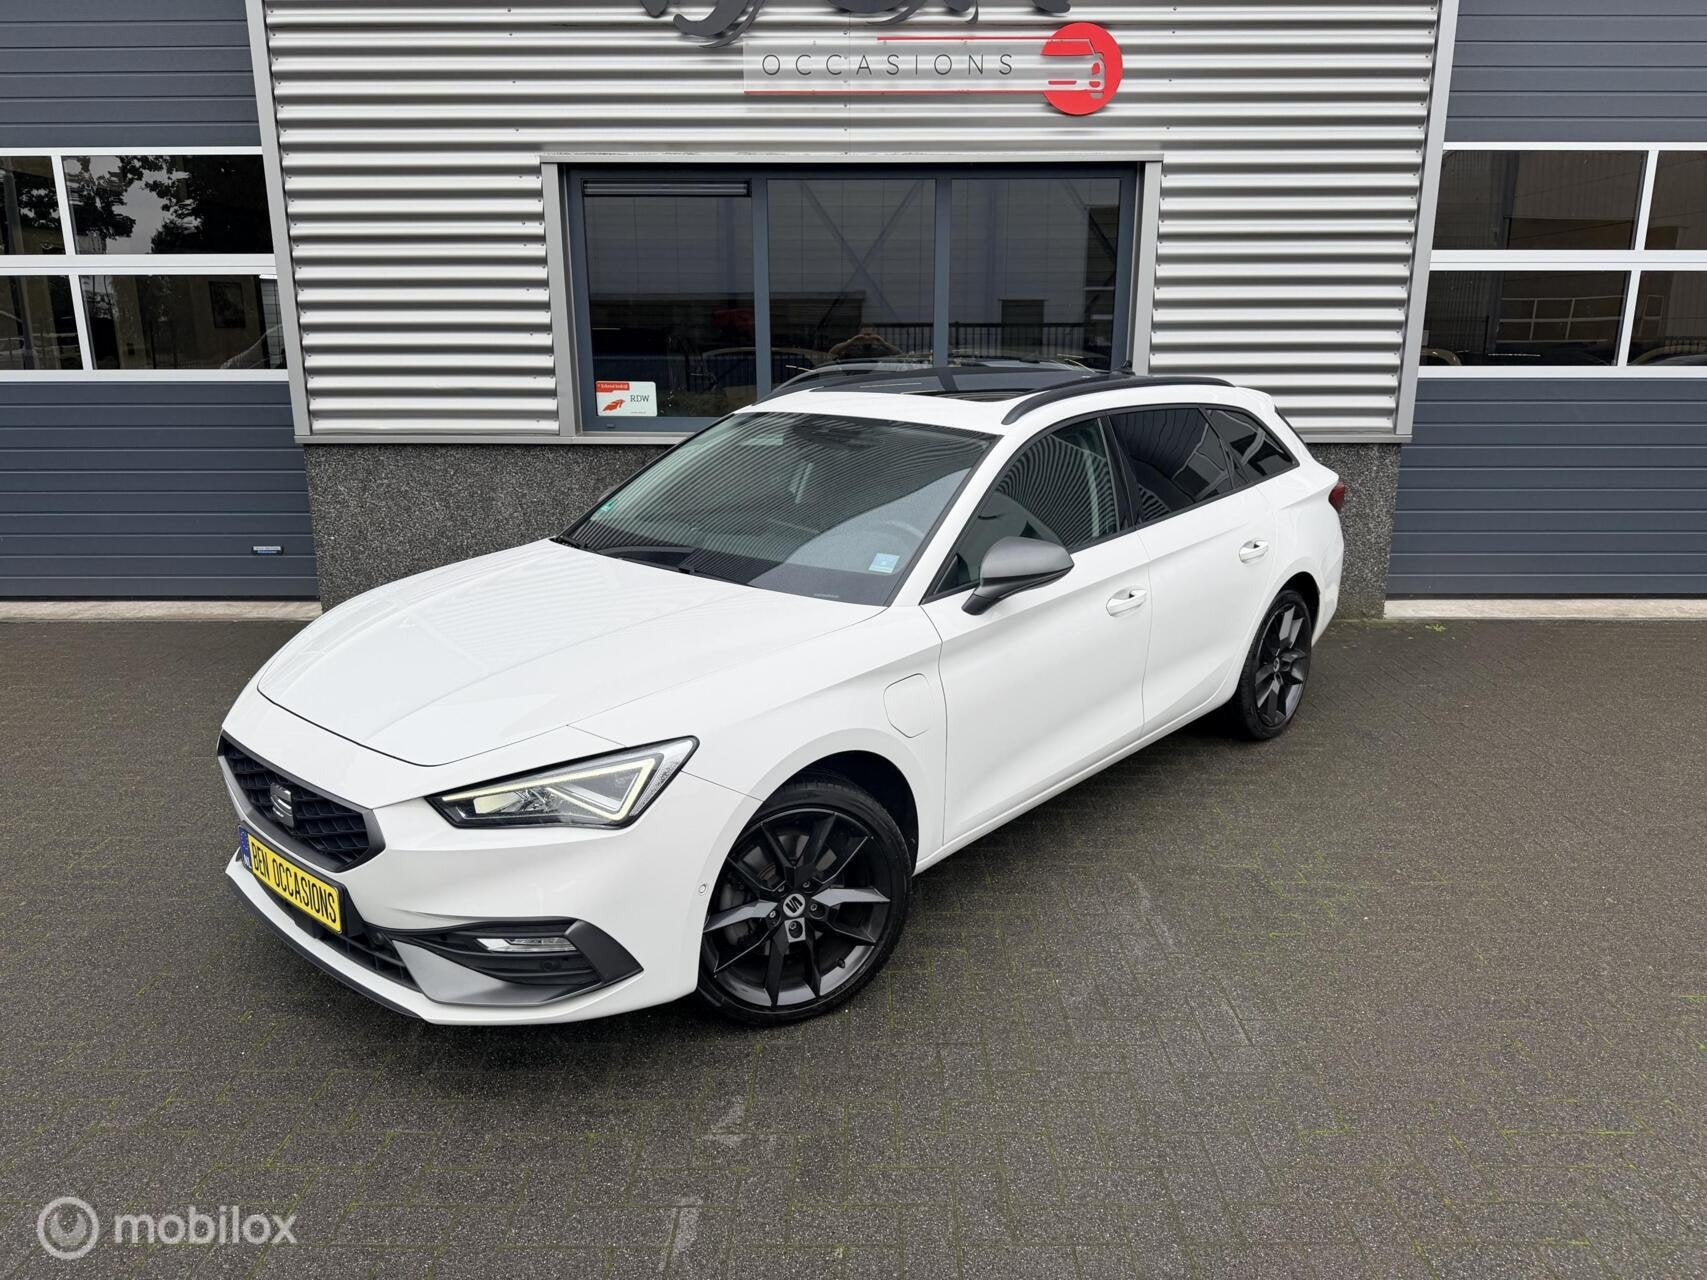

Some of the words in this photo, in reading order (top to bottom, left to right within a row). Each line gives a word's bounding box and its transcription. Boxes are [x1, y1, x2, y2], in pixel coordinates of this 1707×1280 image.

[761, 53, 1012, 76] OCCASIONS
[630, 394, 649, 402] RDW
[251, 841, 270, 880] BEN
[272, 857, 336, 924] OCCASIONS
